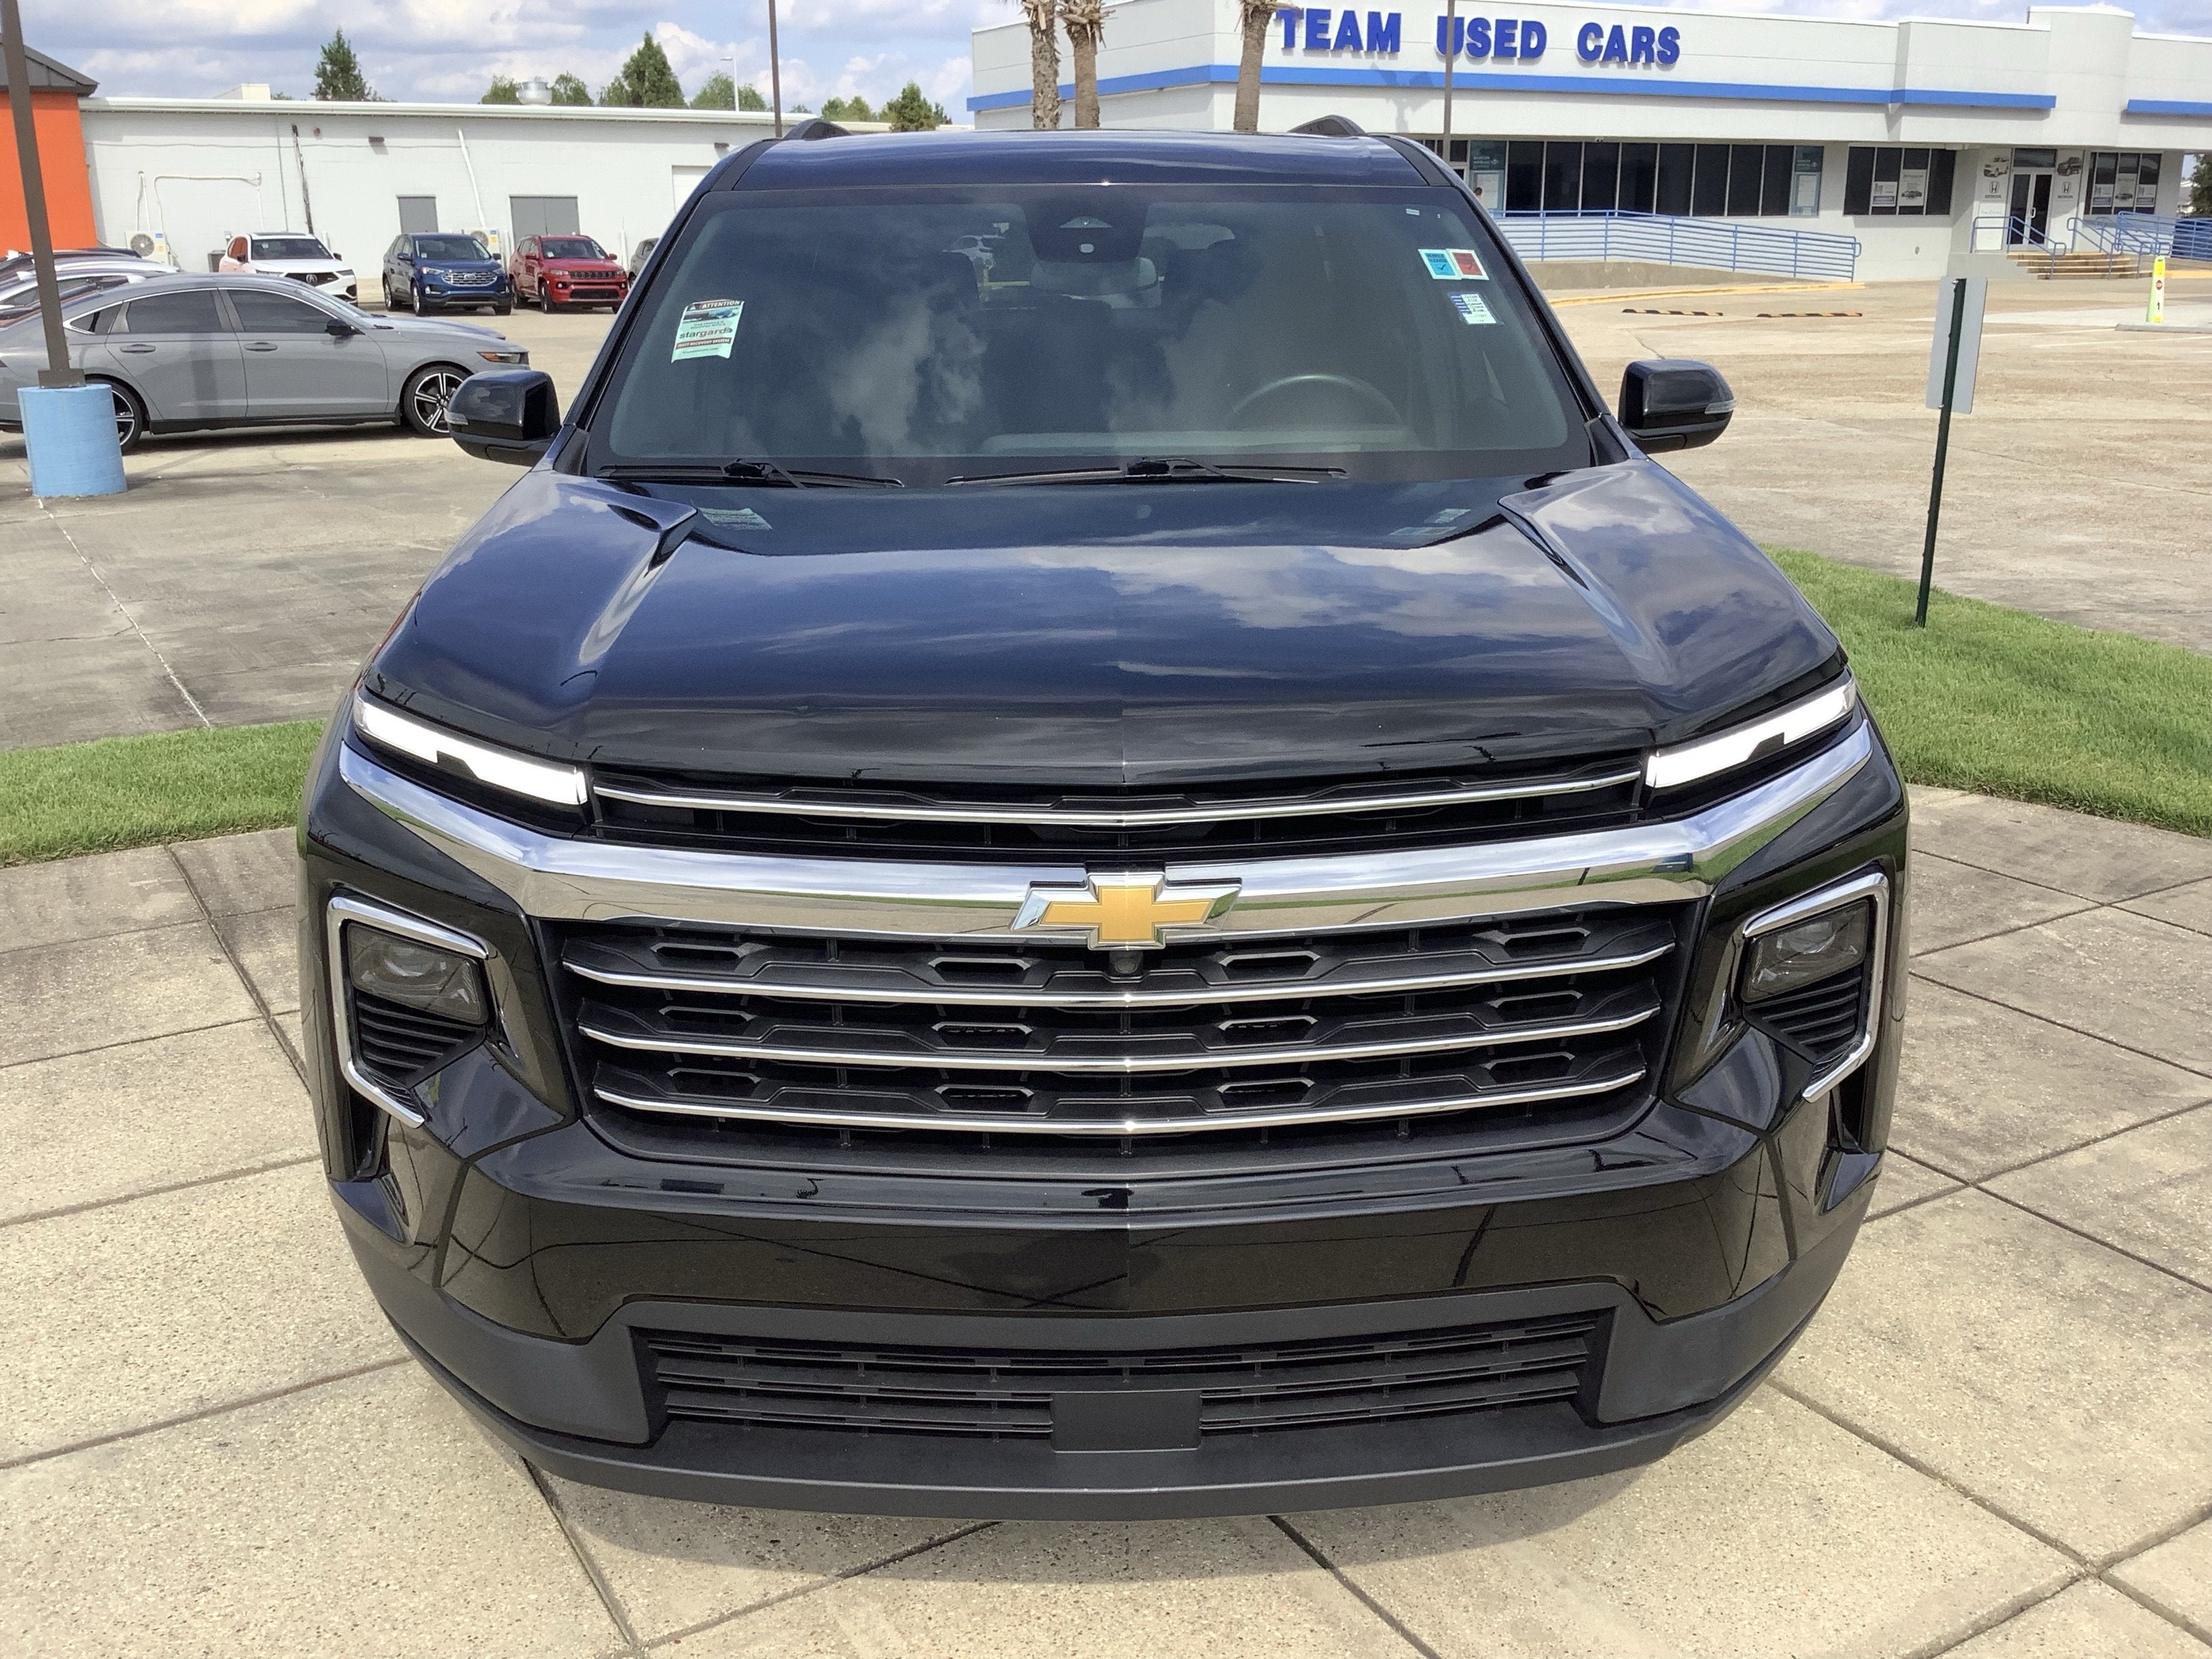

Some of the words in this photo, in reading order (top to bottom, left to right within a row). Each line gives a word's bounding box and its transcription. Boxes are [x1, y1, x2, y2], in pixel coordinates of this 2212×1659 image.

[1275, 8, 1401, 53] TEAM
[1437, 16, 1547, 59] USED
[1578, 22, 1681, 64] CARS
[702, 300, 740, 309] ATTENTION
